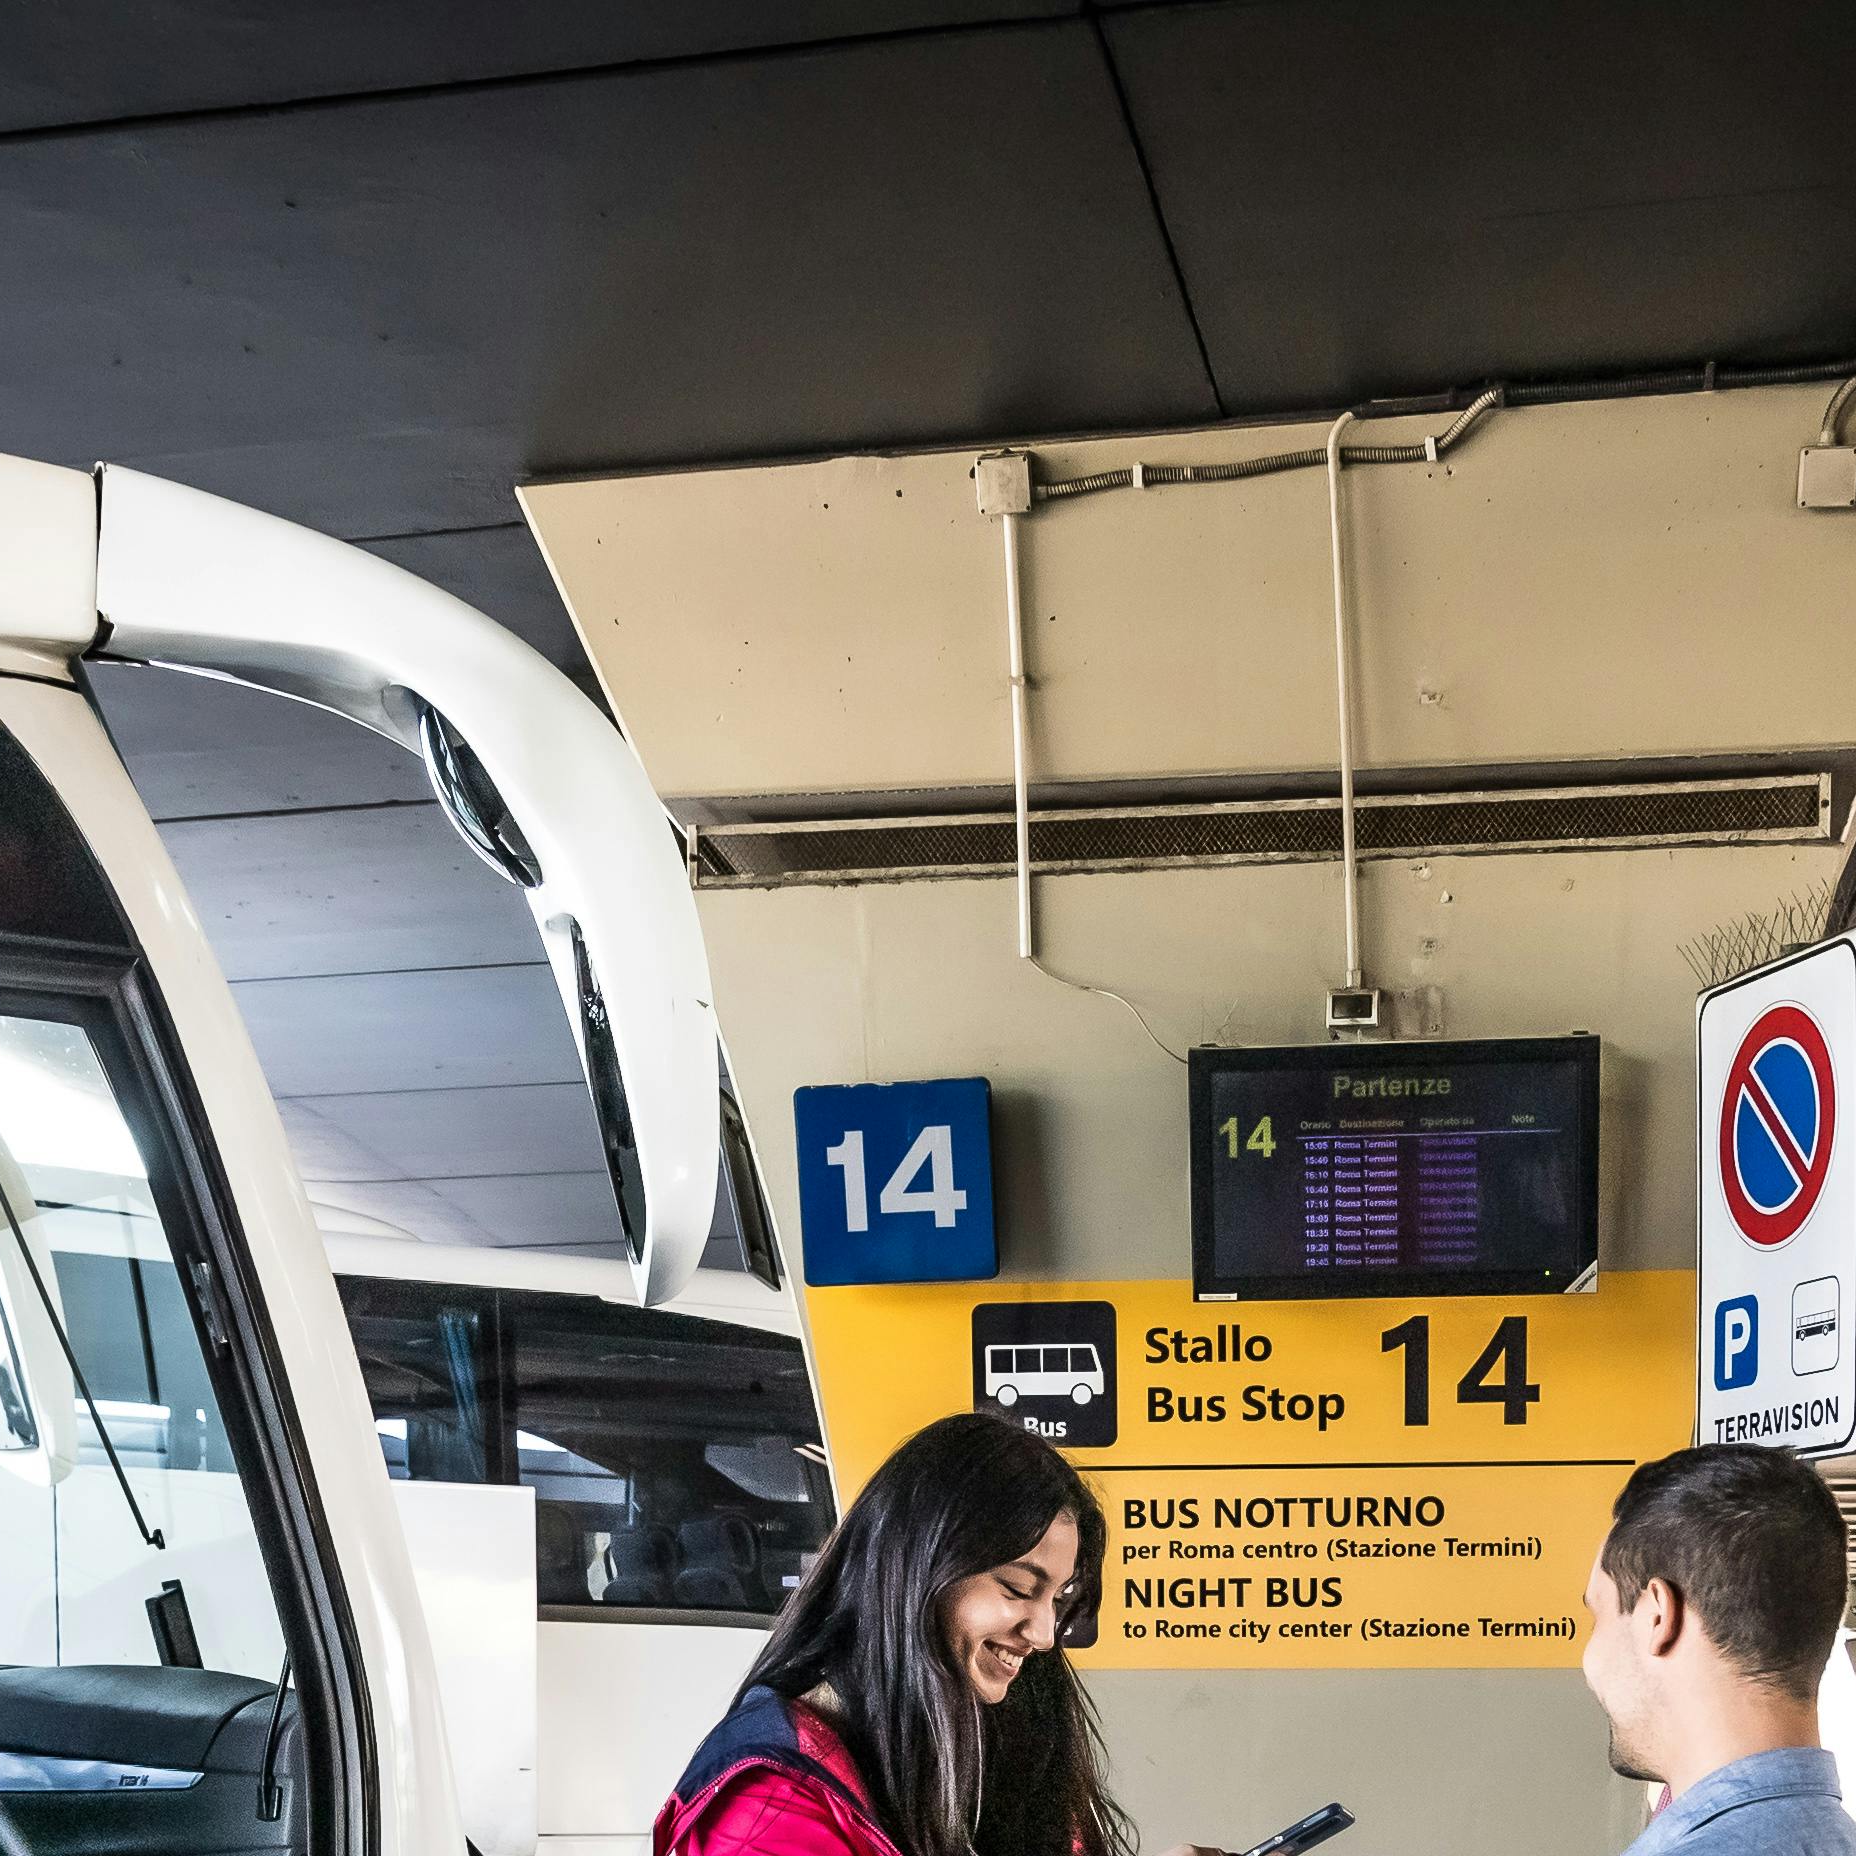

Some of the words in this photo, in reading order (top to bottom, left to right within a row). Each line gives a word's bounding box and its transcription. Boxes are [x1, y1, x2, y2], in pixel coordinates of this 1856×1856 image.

[1333, 1075, 1453, 1099] Partenze
[1218, 1115, 1278, 1159] 14
[1334, 1141, 1361, 1150] Roma
[1363, 1140, 1398, 1148] Termini
[1334, 1156, 1361, 1164] Roma
[1363, 1155, 1398, 1164] Termini
[826, 1124, 968, 1233] 14
[1334, 1170, 1361, 1178] Roma
[1363, 1170, 1398, 1178] Termini
[1334, 1184, 1361, 1193] Roma
[1363, 1184, 1398, 1192] Termini
[1334, 1200, 1361, 1208] Roma
[1363, 1199, 1398, 1208] Termini
[1334, 1214, 1361, 1222] Roma
[1363, 1213, 1398, 1222] Termini
[1334, 1228, 1361, 1237] Roma
[1363, 1228, 1398, 1236] Termini
[1334, 1243, 1361, 1252] Roma
[1363, 1242, 1398, 1250] Termini
[1145, 1324, 1273, 1364] Stallo
[1724, 1307, 1752, 1380] P
[1381, 1315, 1541, 1427] 14
[1147, 1386, 1227, 1423] Bus
[1242, 1384, 1345, 1432] Stop
[1714, 1395, 1839, 1444] TERRAVISION
[1023, 1416, 1067, 1438] Bus
[1123, 1498, 1200, 1530] BUS
[1214, 1495, 1445, 1529] NOTTURNO
[1122, 1545, 1161, 1565] per
[1169, 1540, 1235, 1559] Roma
[1242, 1540, 1318, 1559] centro
[1326, 1537, 1436, 1562] (Stazione
[1443, 1536, 1542, 1561] Termini)
[1124, 1577, 1253, 1609] NIGHT
[1266, 1576, 1343, 1608] BUS
[1122, 1621, 1147, 1639] to
[1155, 1619, 1222, 1639] Rome
[1228, 1618, 1271, 1644] city
[1278, 1620, 1353, 1638] center
[1360, 1617, 1470, 1641] (Stazione
[1477, 1616, 1576, 1641] Termini)
